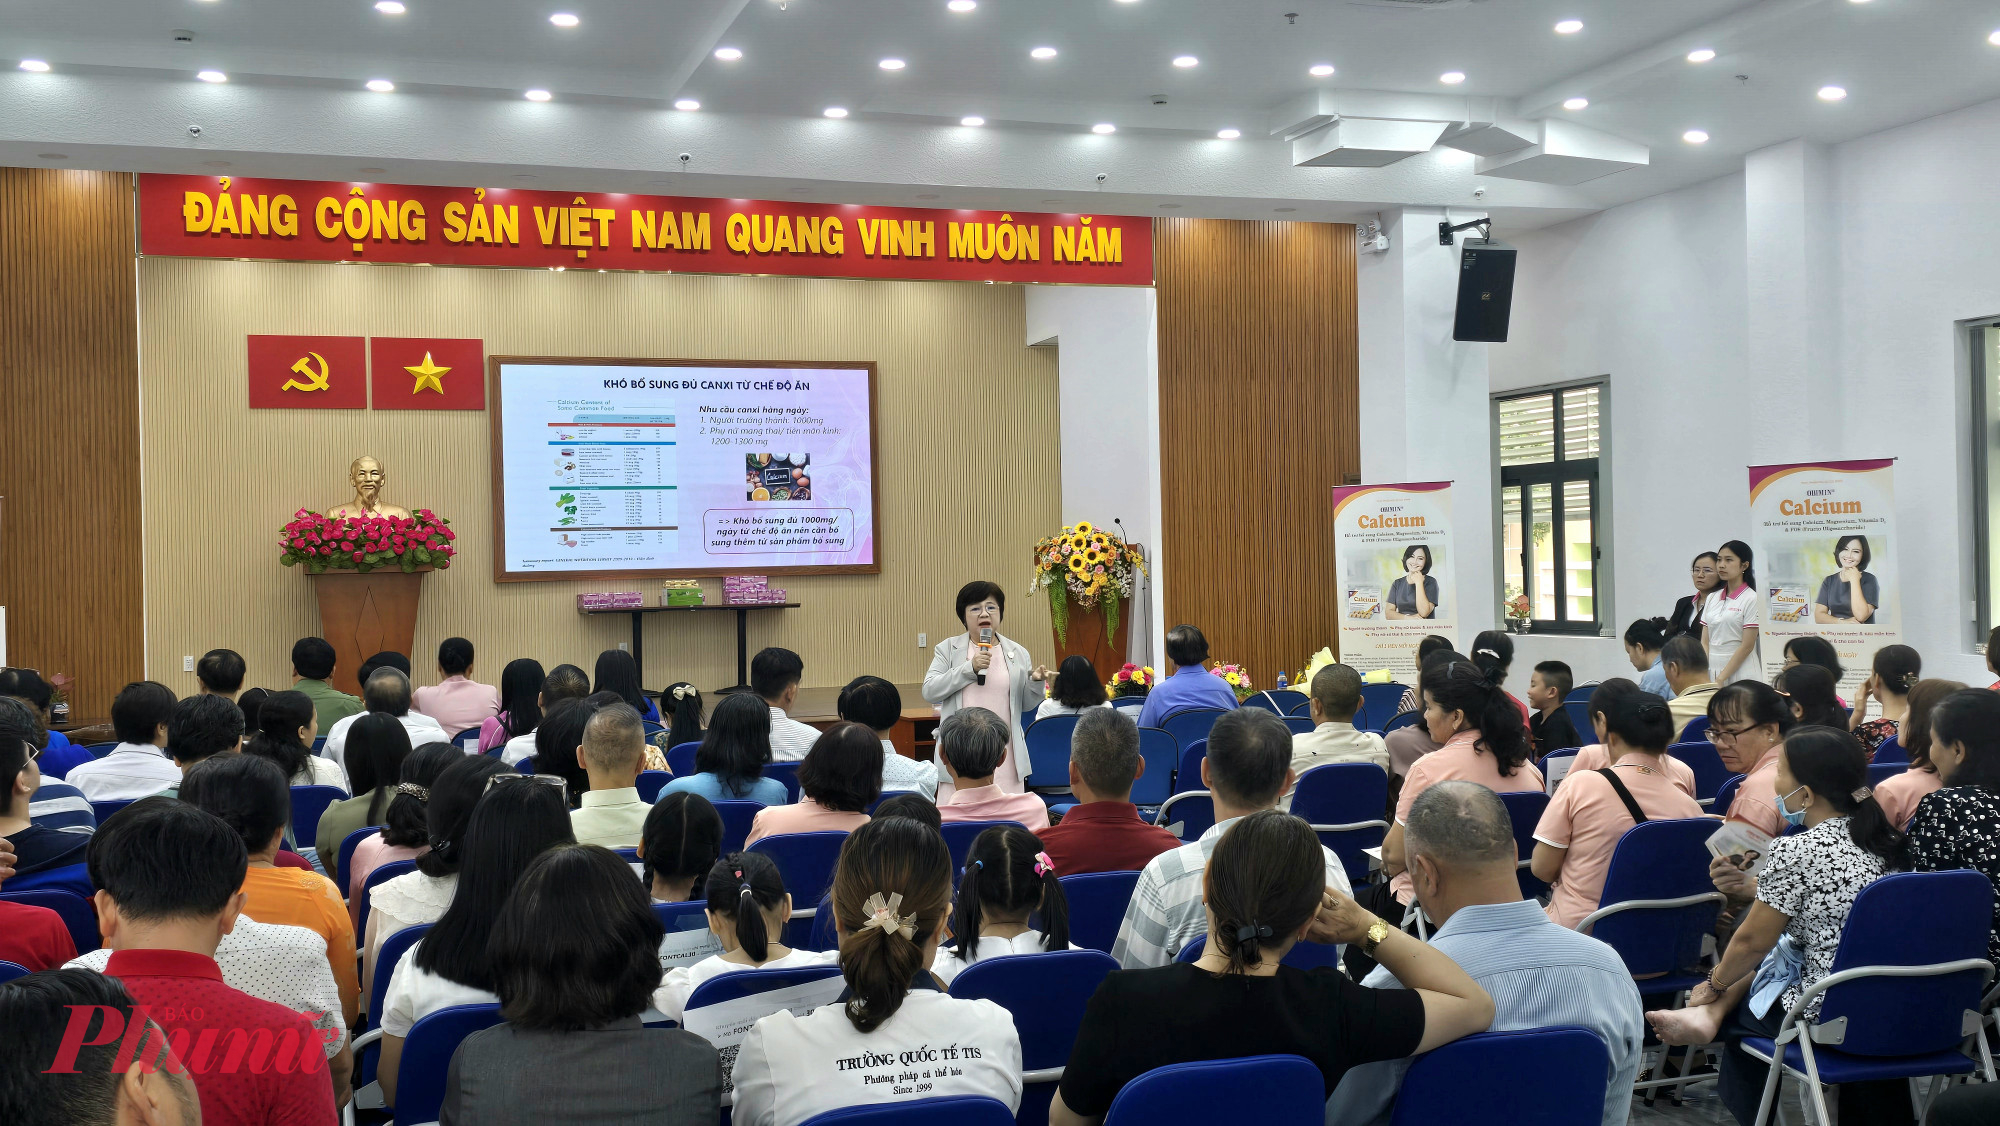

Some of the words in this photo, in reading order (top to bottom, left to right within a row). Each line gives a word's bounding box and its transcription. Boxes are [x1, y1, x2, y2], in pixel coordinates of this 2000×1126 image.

[183, 177, 299, 237] ĐẢNG
[315, 187, 427, 252] CỘNG
[443, 188, 520, 244] SẢN
[534, 197, 615, 258] VIỆT
[632, 209, 710, 250] NAM
[726, 212, 844, 255] QUANG
[857, 217, 935, 257] VINH
[948, 214, 1040, 261] MUÔN
[1053, 217, 1122, 263] NĂM
[603, 378, 628, 389] KHÓ
[630, 377, 646, 389] BỔ
[649, 380, 679, 389] SUNG
[682, 378, 697, 390] ĐỦ
[700, 381, 733, 390] CANXI
[736, 379, 751, 390] TỪ
[753, 379, 774, 391] CHẾ
[776, 381, 792, 392] ĐỘ
[794, 379, 810, 391] ĂN
[763, 406, 783, 414] hàng
[793, 417, 823, 425] 1000mg
[710, 428, 725, 436] Phụ
[756, 439, 768, 447] mg
[1780, 499, 1862, 516] Calcium
[801, 516, 838, 525] 1000mg/
[1358, 514, 1425, 529] Calcium
[717, 528, 737, 537] ngày
[711, 539, 731, 547] sung
[734, 538, 756, 546] thêm
[825, 537, 845, 545] sung
[836, 1051, 895, 1071] TRƯỜNG
[900, 1045, 938, 1067] QUỐC
[941, 1043, 959, 1060] TẾ
[962, 1047, 982, 1059] TIS
[864, 1074, 895, 1085] Phương
[899, 1071, 918, 1083] pháp
[923, 1070, 931, 1079] cá
[935, 1066, 947, 1078] thể
[893, 1085, 913, 1095] Since
[916, 1083, 933, 1092] 1999
